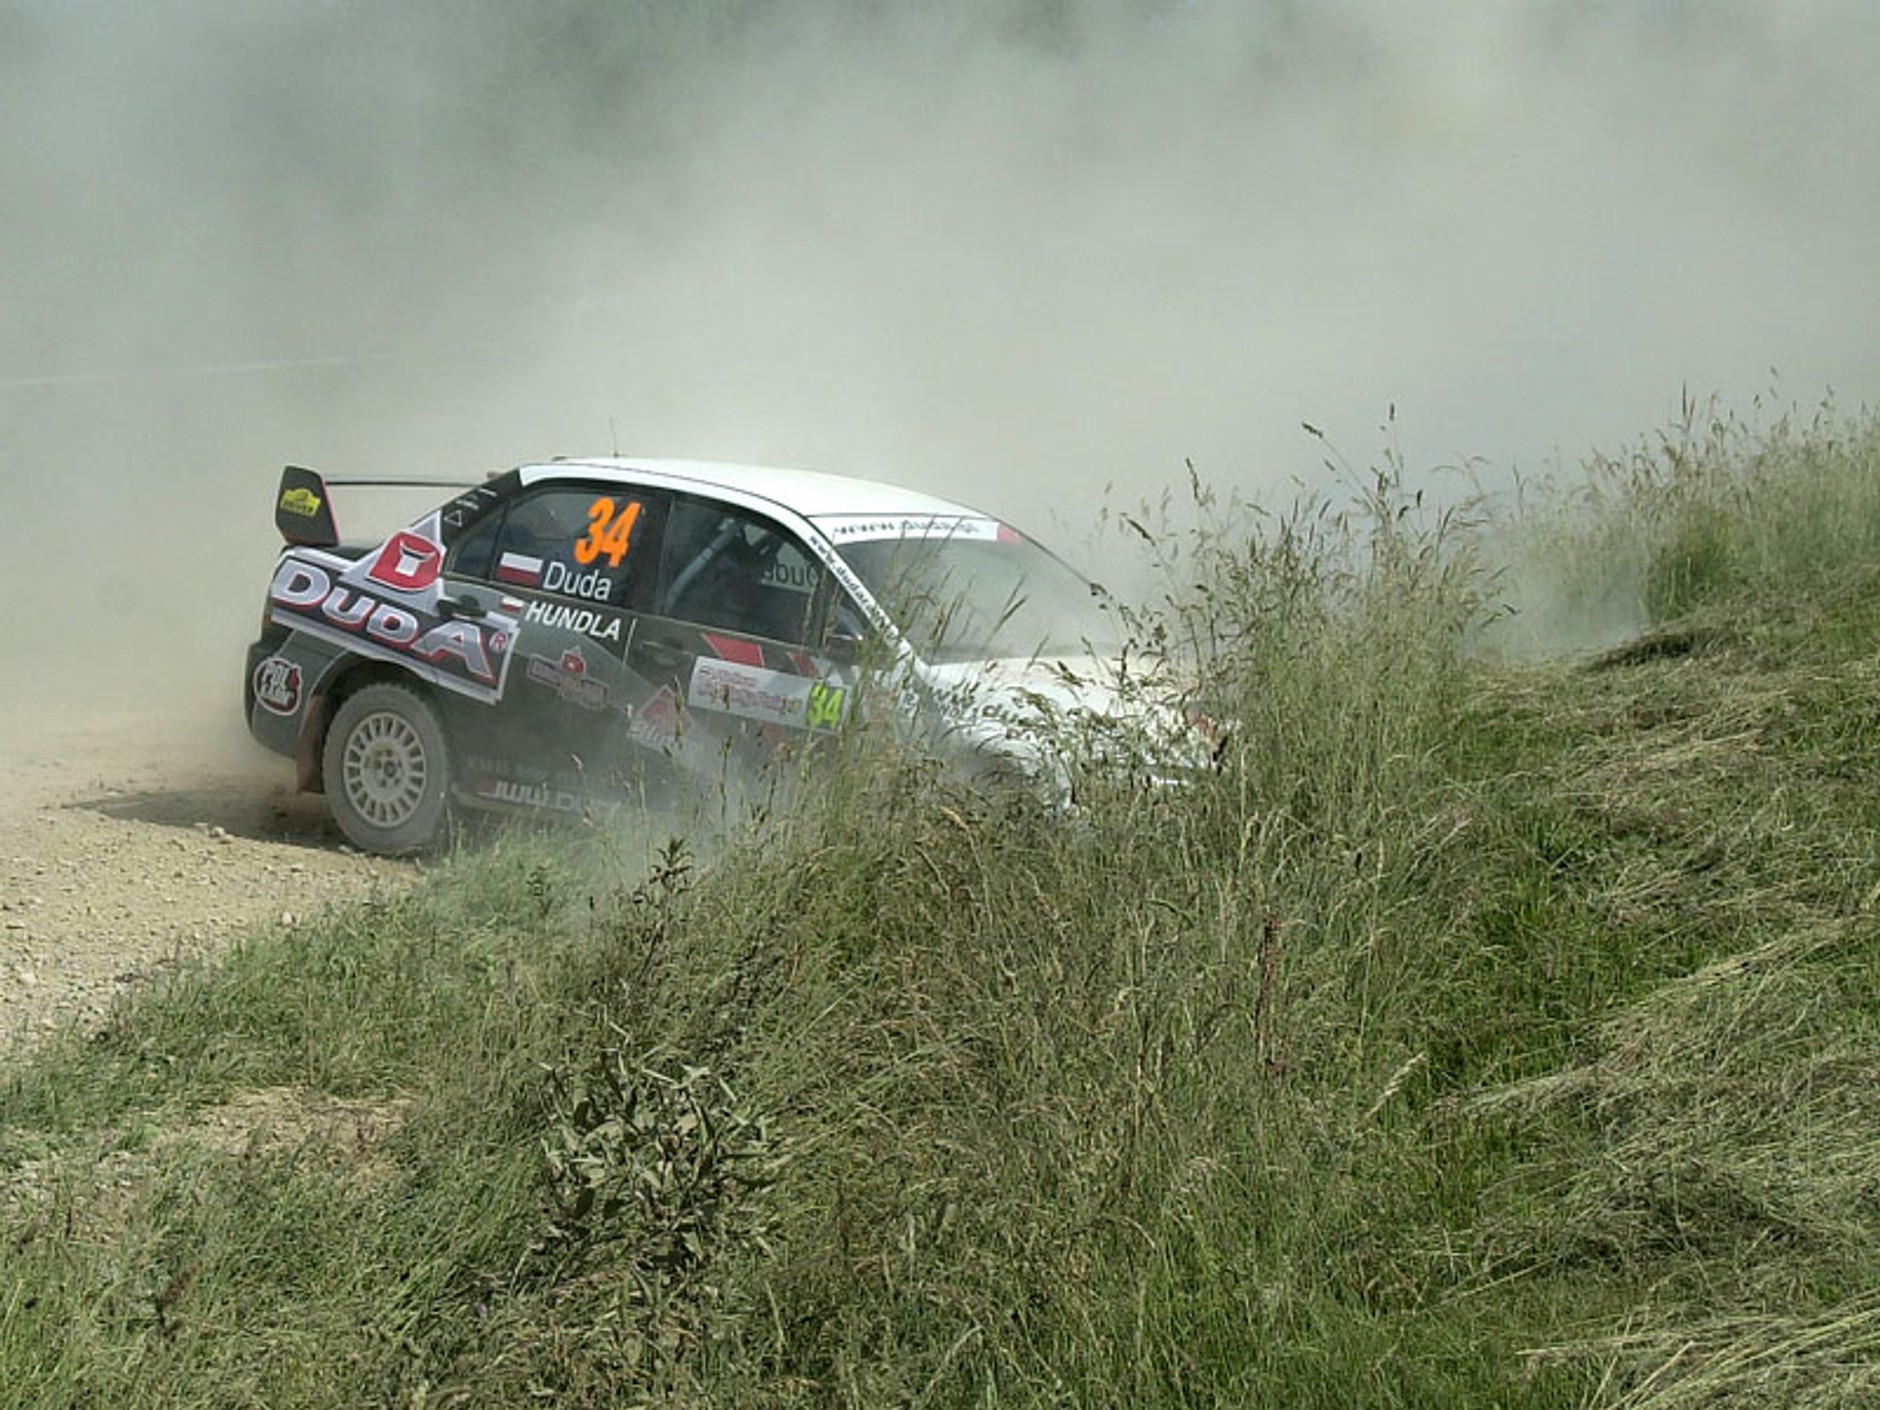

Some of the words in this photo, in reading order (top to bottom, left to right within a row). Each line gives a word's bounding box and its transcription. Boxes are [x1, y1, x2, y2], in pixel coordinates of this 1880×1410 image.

[574, 496, 641, 567] 34
[543, 561, 612, 600] Duda
[272, 558, 497, 684] DUDA
[525, 600, 622, 641] HUNDLA
[808, 680, 845, 729] 34
